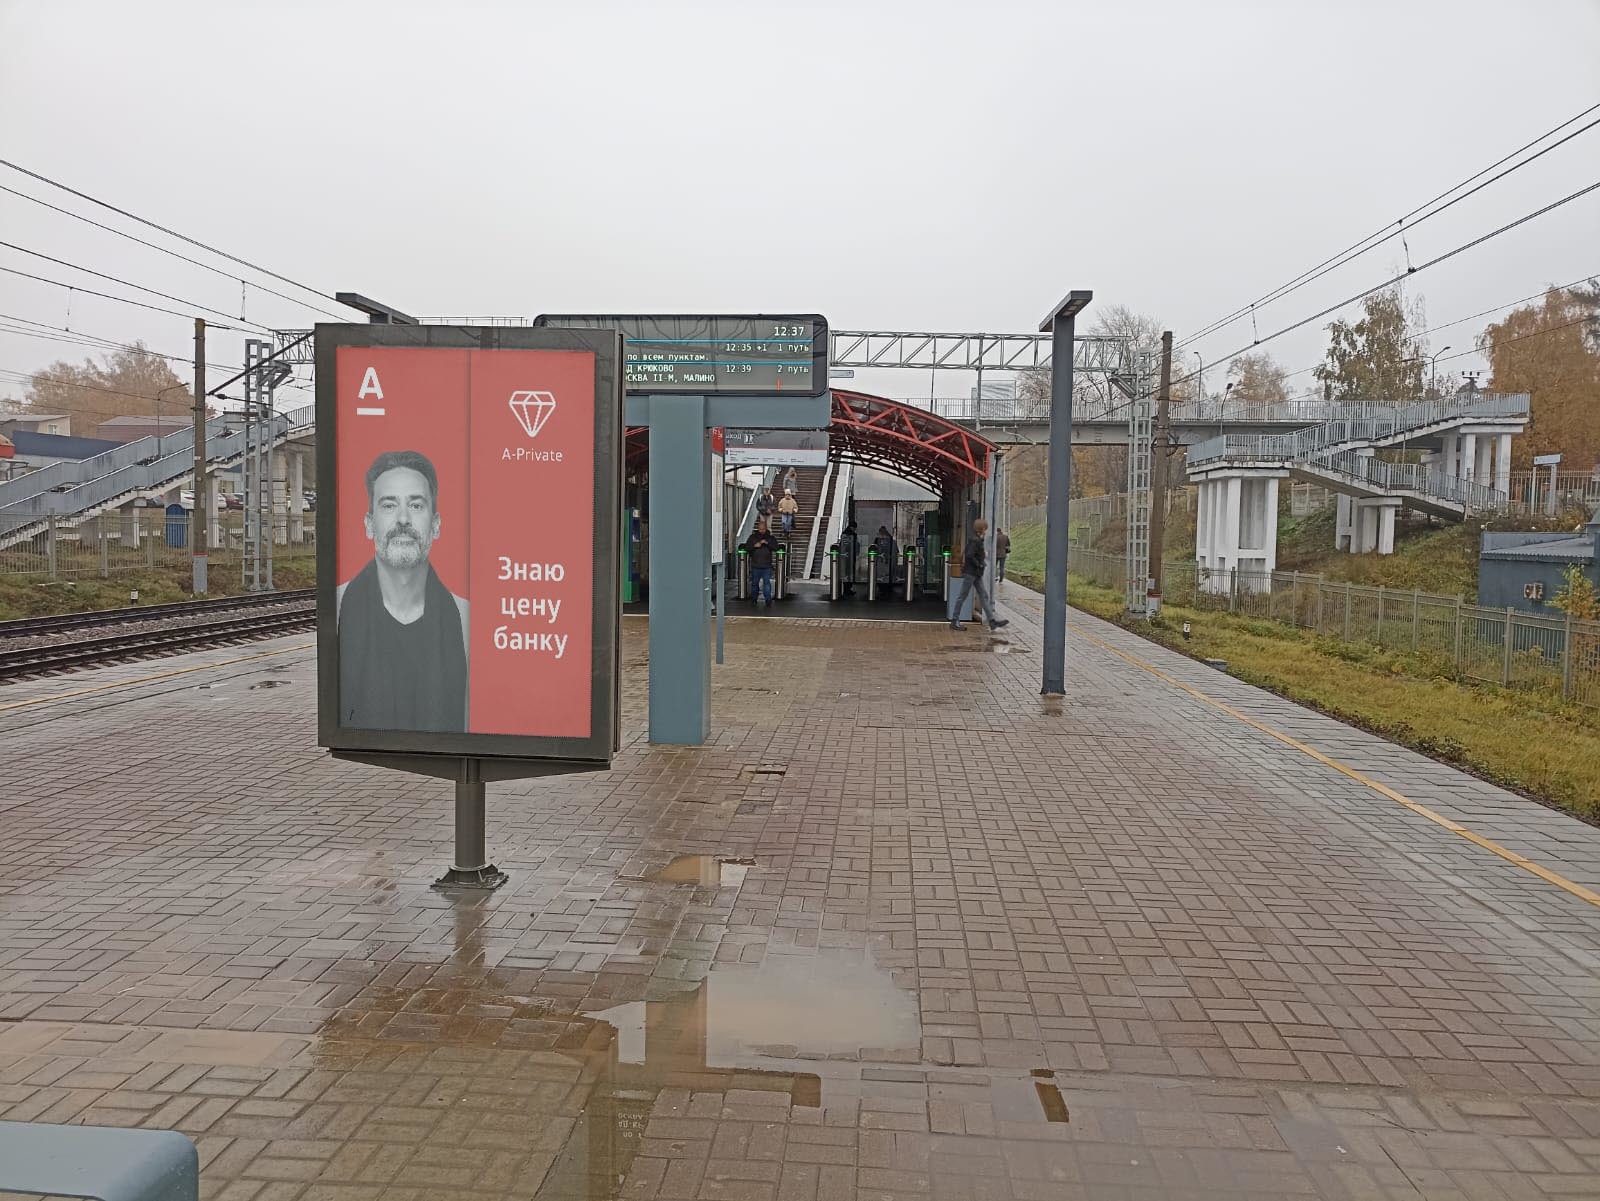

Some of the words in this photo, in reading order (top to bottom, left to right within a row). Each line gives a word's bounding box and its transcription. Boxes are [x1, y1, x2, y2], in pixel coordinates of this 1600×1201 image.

[774, 326, 805, 337] 12:37
[726, 343, 752, 352] 12:35
[778, 343, 783, 352] 1
[788, 344, 809, 353] путь
[668, 354, 709, 362] пунктам.
[637, 364, 674, 373] КРЮКОВО
[726, 364, 752, 373] 12:39
[777, 364, 783, 373] 2
[787, 365, 809, 375] путь
[625, 373, 648, 382] СКВА
[683, 374, 716, 382] МАЛИНО
[501, 447, 564, 463] A-Private
[497, 555, 565, 583] Знаю
[500, 597, 562, 625] цену
[493, 625, 568, 660] банку
